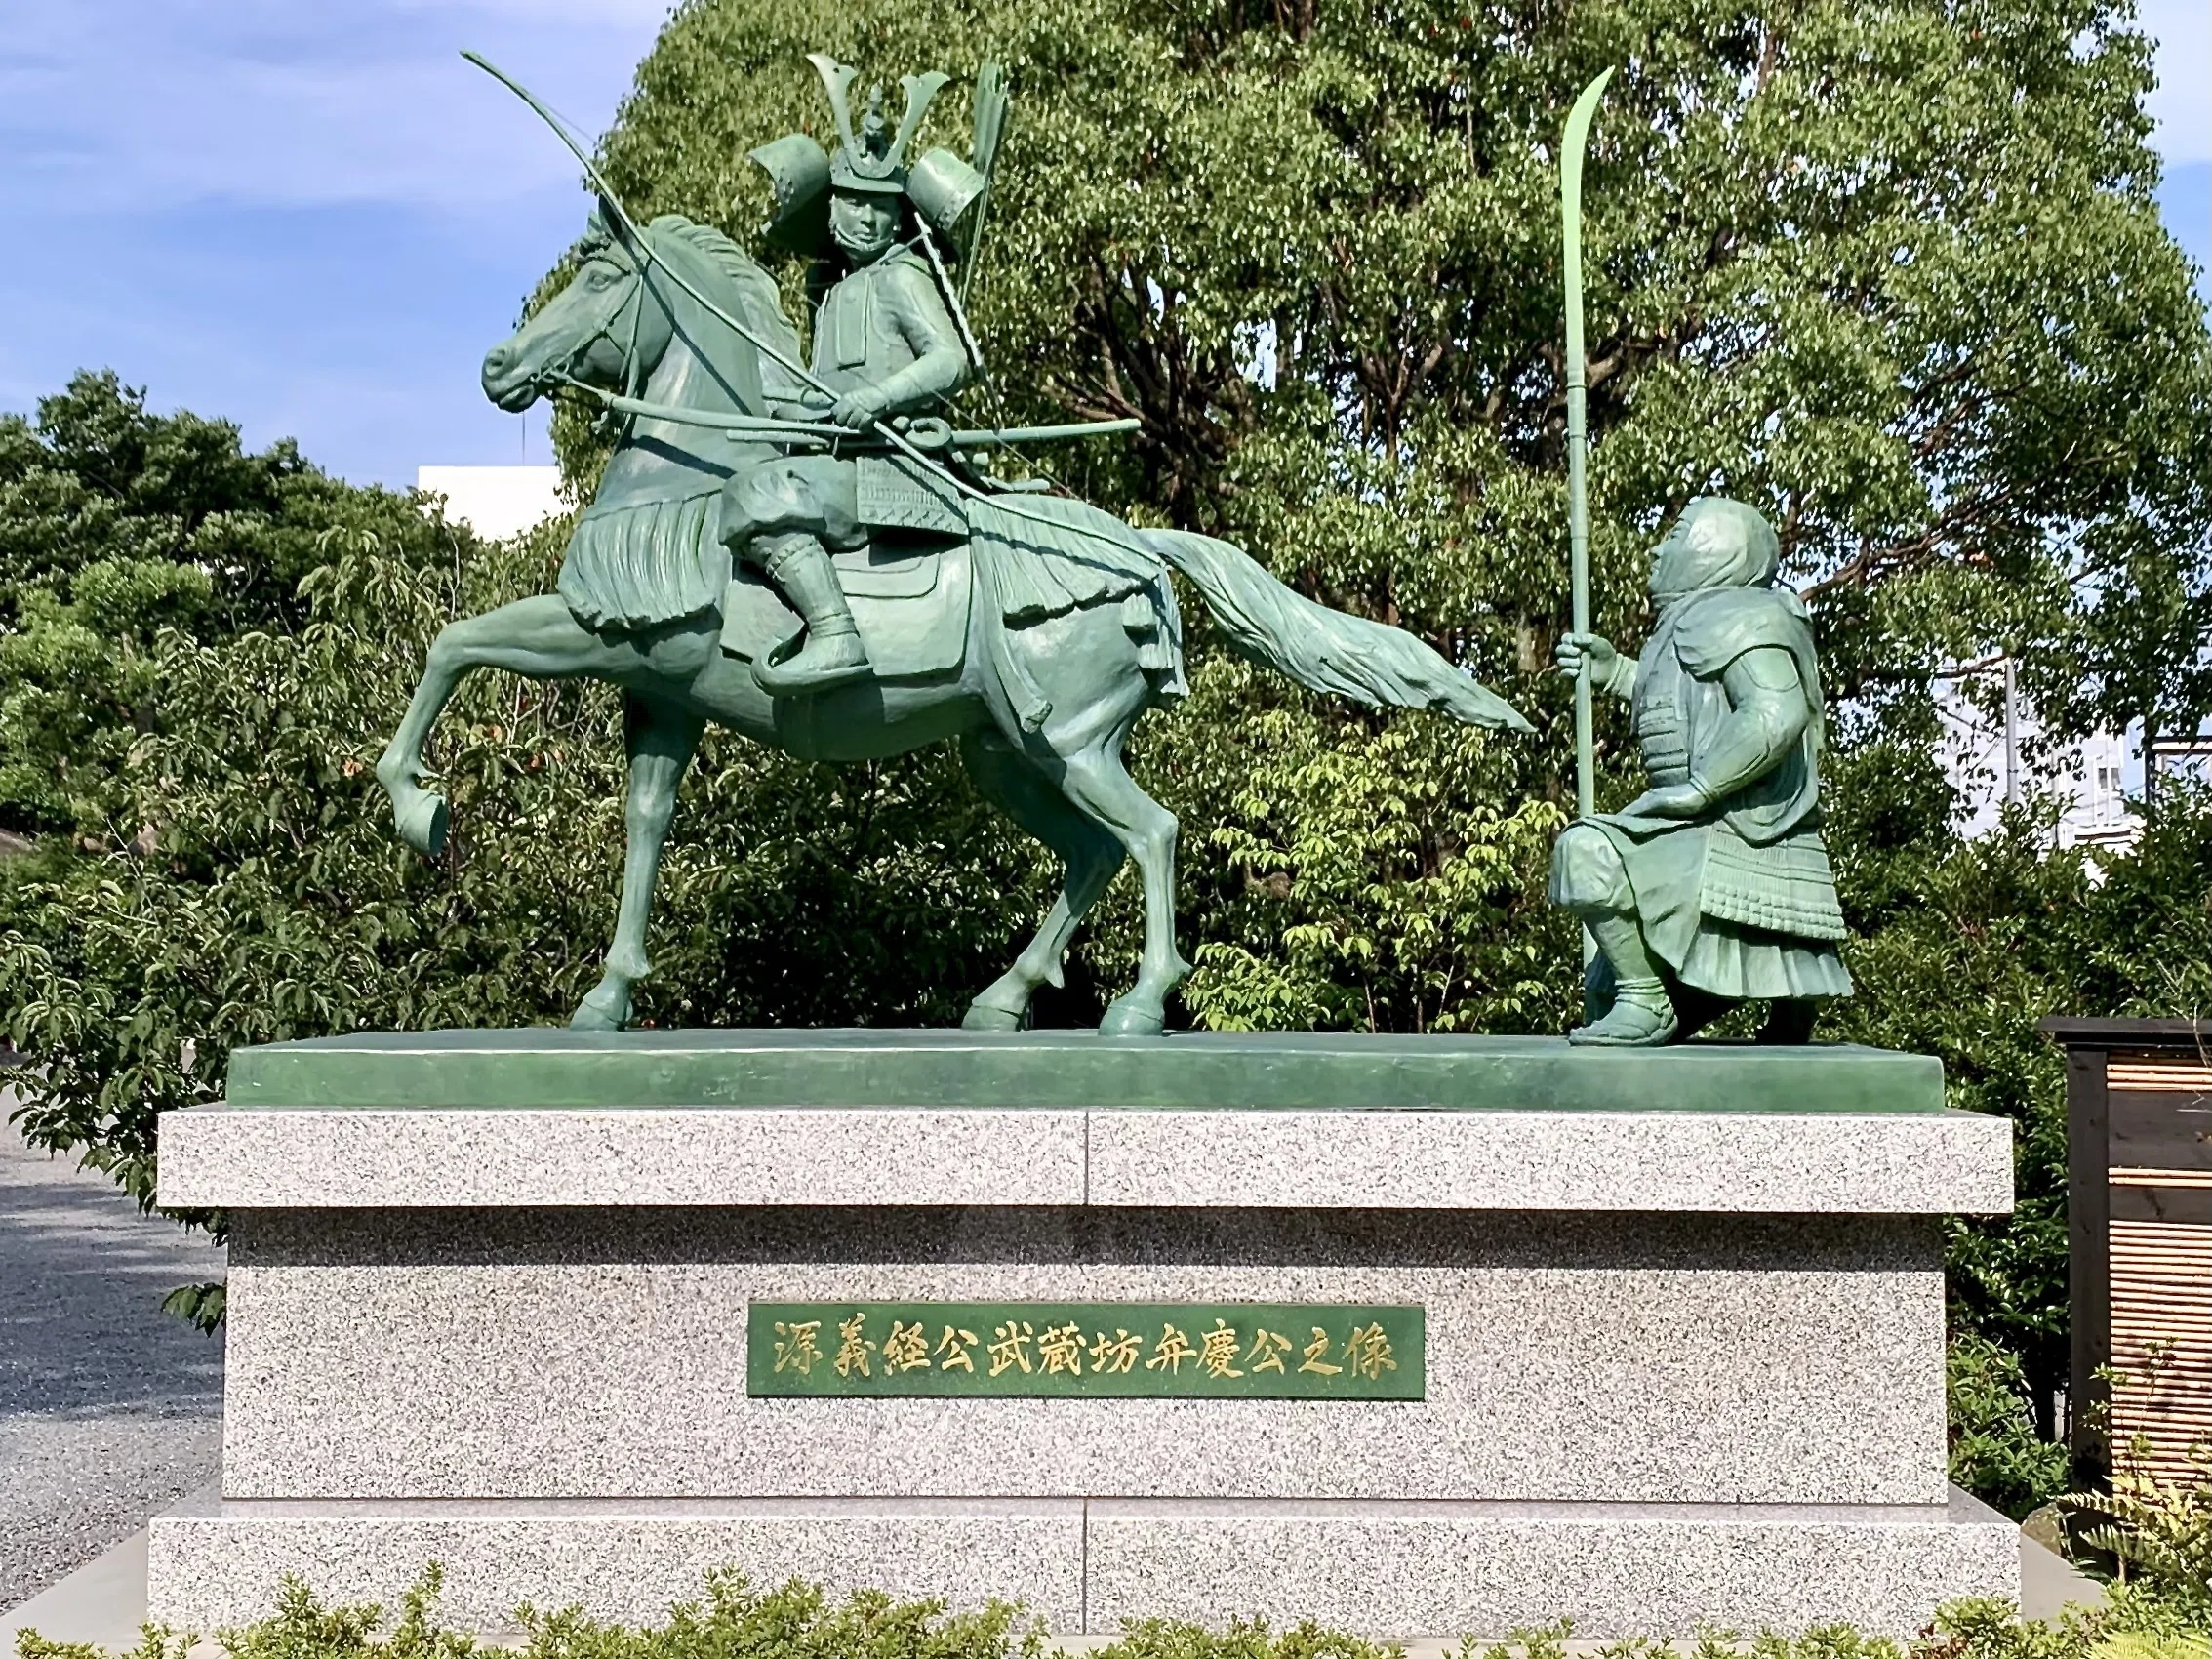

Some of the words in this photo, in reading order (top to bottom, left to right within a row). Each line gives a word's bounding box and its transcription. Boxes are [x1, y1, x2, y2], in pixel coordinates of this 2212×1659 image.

[774, 1312, 1397, 1381] 源義経公武蔵坊弁慶公之像
